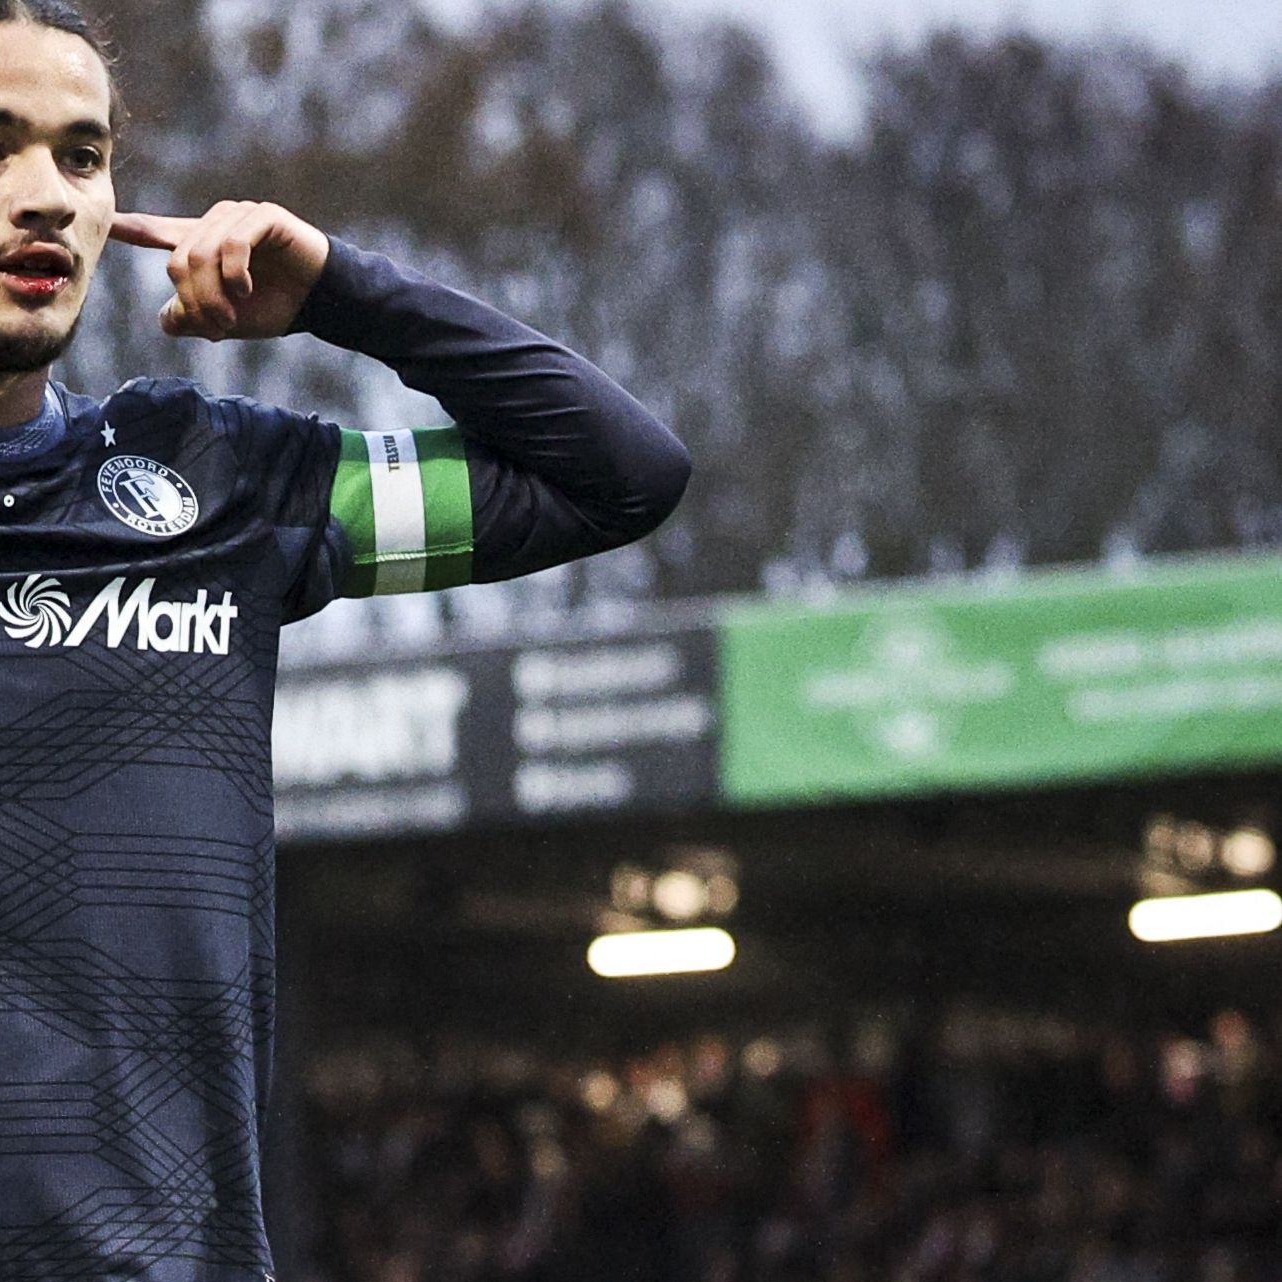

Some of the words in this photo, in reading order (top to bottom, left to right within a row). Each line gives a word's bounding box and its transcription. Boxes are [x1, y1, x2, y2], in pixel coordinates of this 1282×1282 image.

[101, 458, 168, 493] FEYENOORD
[126, 496, 196, 533] ROTTERDAM
[62, 577, 238, 656] Markt
